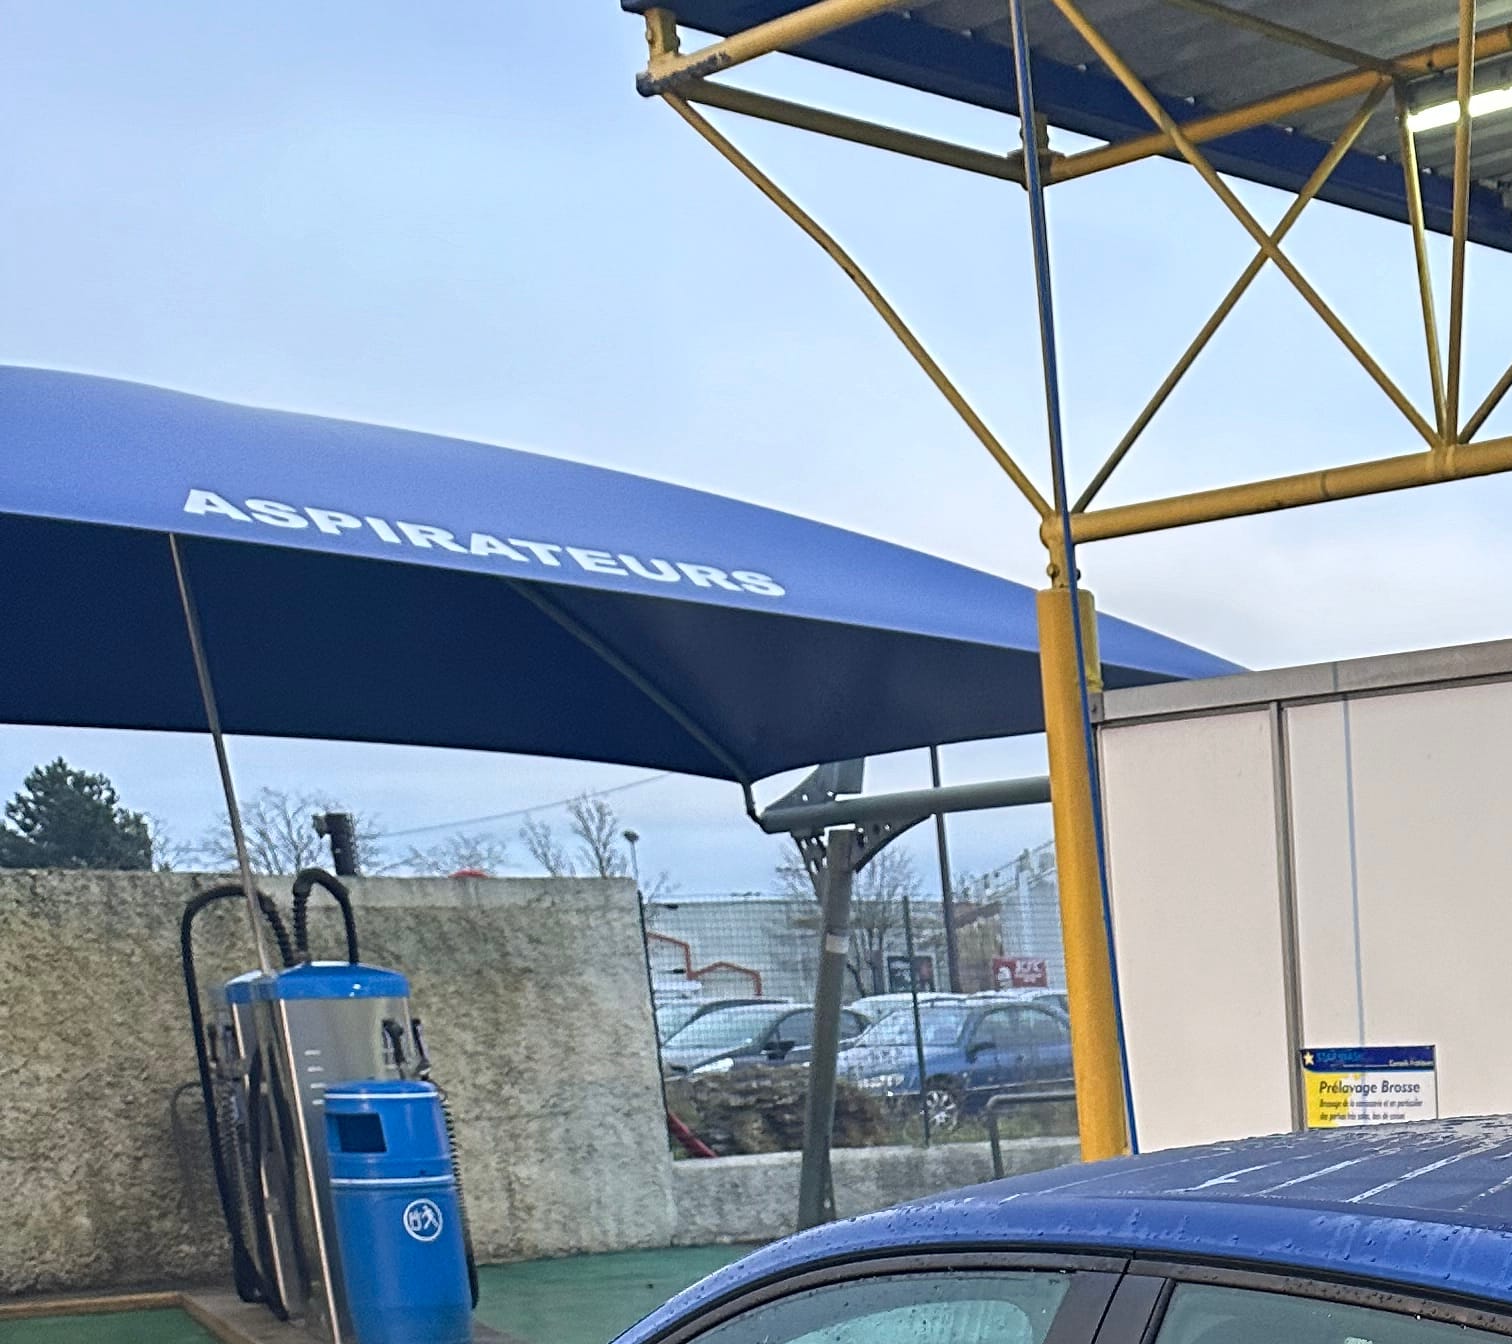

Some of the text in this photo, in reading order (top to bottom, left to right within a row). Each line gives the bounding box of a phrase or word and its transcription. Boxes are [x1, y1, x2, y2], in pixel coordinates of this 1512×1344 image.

[183, 488, 786, 597] ASPIRATEURS
[1319, 1080, 1420, 1096] Prélavage Brosse
